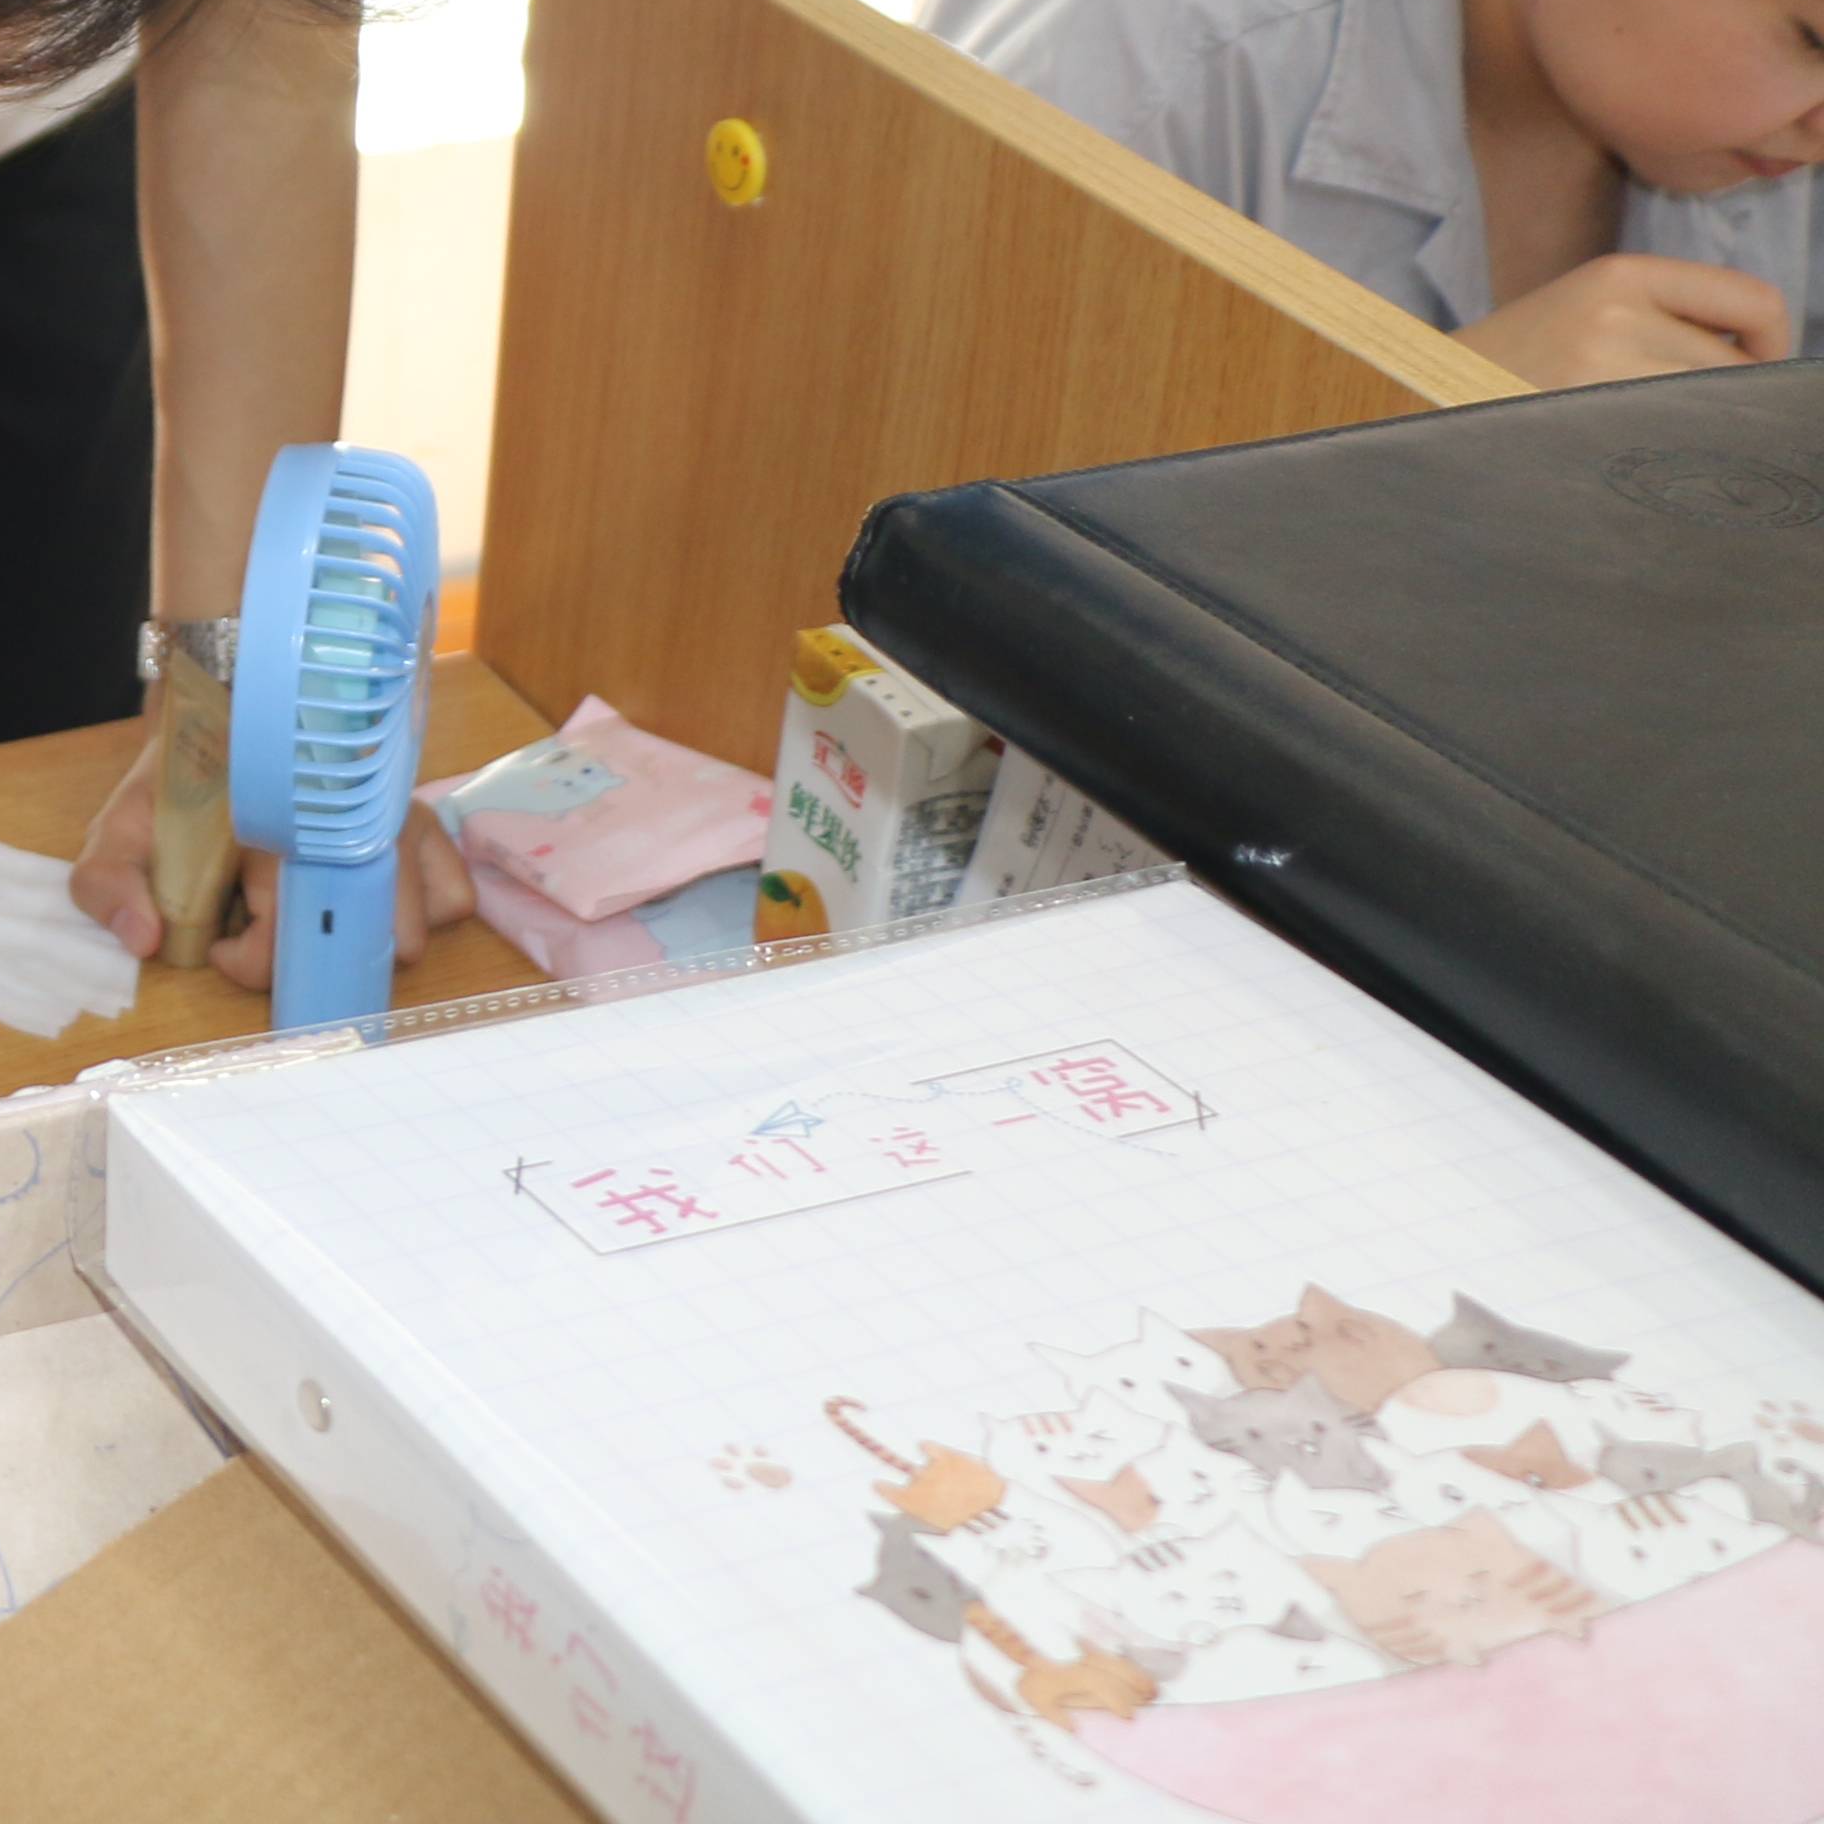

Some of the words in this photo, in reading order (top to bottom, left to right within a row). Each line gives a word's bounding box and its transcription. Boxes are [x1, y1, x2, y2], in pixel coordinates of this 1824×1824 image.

[572, 1056, 1170, 1233] 我们这一窝
